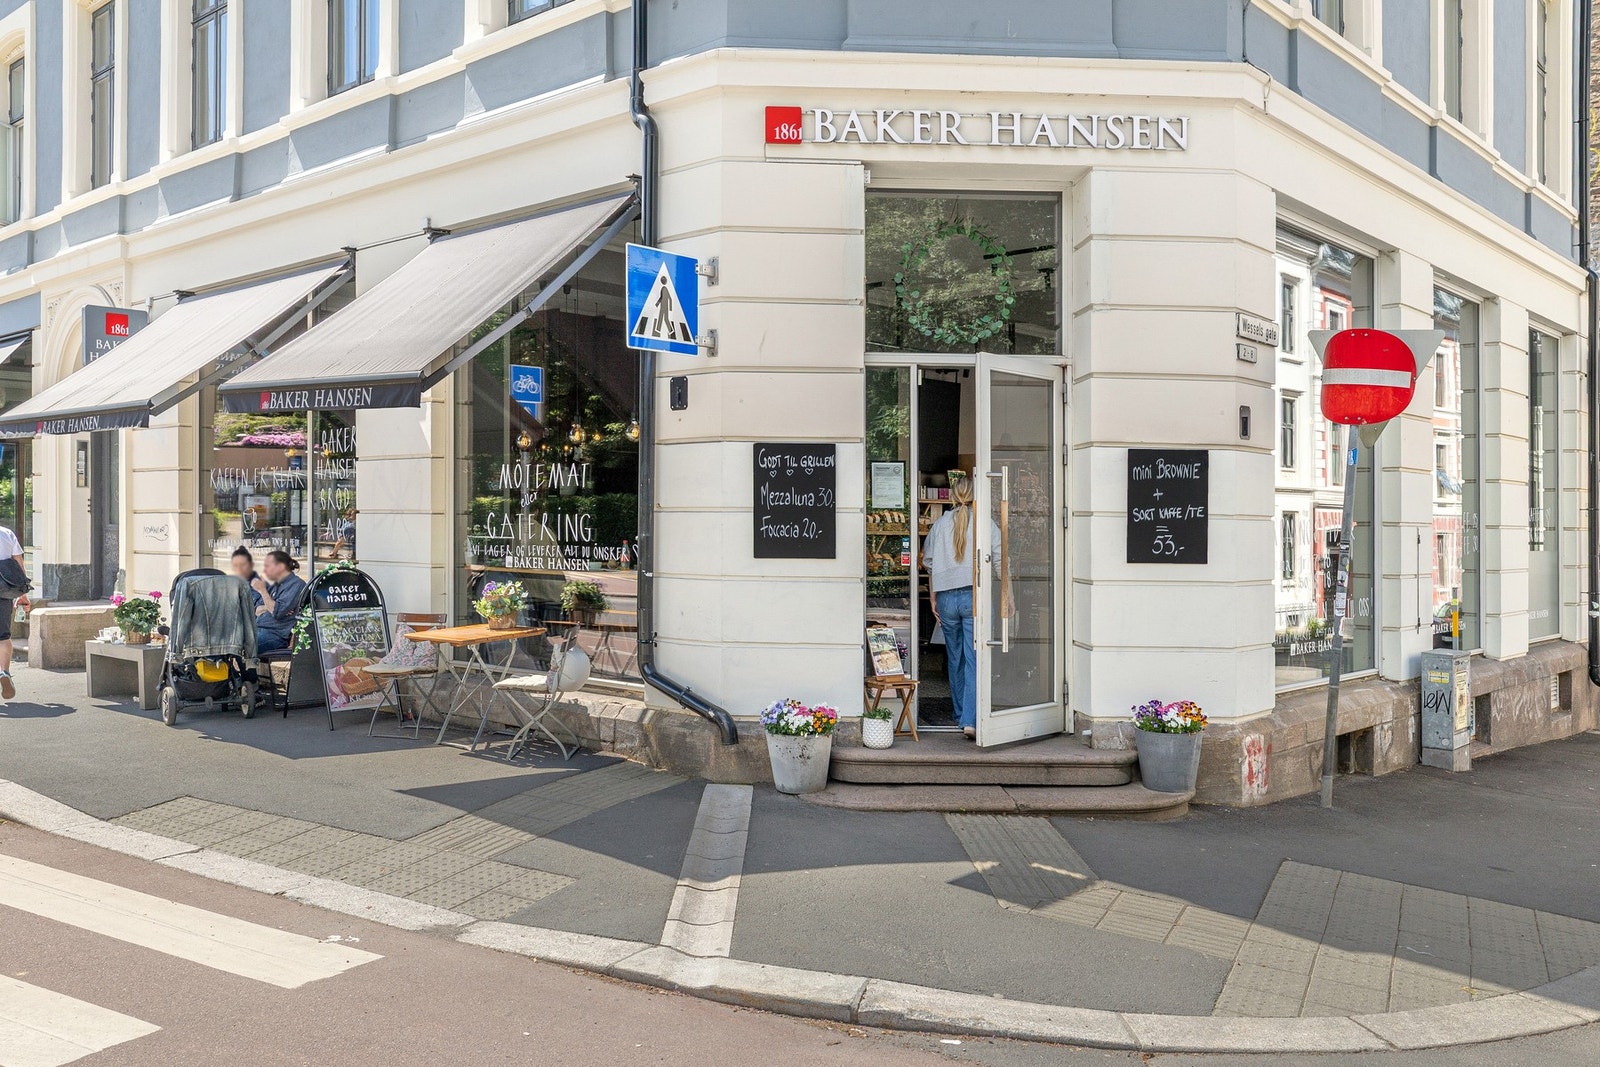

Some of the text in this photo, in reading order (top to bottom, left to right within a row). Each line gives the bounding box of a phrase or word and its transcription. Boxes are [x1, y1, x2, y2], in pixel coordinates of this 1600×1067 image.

[774, 122, 802, 140] 1861
[811, 108, 1190, 151] BAKER HANSEN
[111, 323, 129, 335] 1861
[1241, 317, 1277, 341] Wessels gate
[96, 339, 121, 350] BAK
[269, 387, 373, 410] BAKER HANSEN
[42, 415, 100, 434] BAKER HANSEN
[321, 425, 357, 454] BAKER
[758, 448, 835, 469] GODT TIL GRILLEN
[1132, 458, 1202, 480] mini BROWNIE
[210, 467, 249, 489] KAFFEN
[521, 491, 538, 507] eller
[760, 482, 815, 510] Mezzaluna
[487, 507, 592, 542] CATERING
[1132, 507, 1156, 522] SORT
[1159, 507, 1182, 519] KAFFE
[760, 515, 800, 538] Foccacia
[484, 543, 513, 557] LAGER
[515, 545, 525, 556] OG
[527, 544, 563, 558] LEVERER
[564, 544, 579, 557] ALT
[581, 545, 591, 559] DU
[1152, 534, 1185, 556] 53,-
[514, 556, 545, 569] BAKER
[547, 557, 590, 571] HANSEN
[1296, 641, 1317, 655] BAKER
[1318, 639, 1333, 653] HAN
